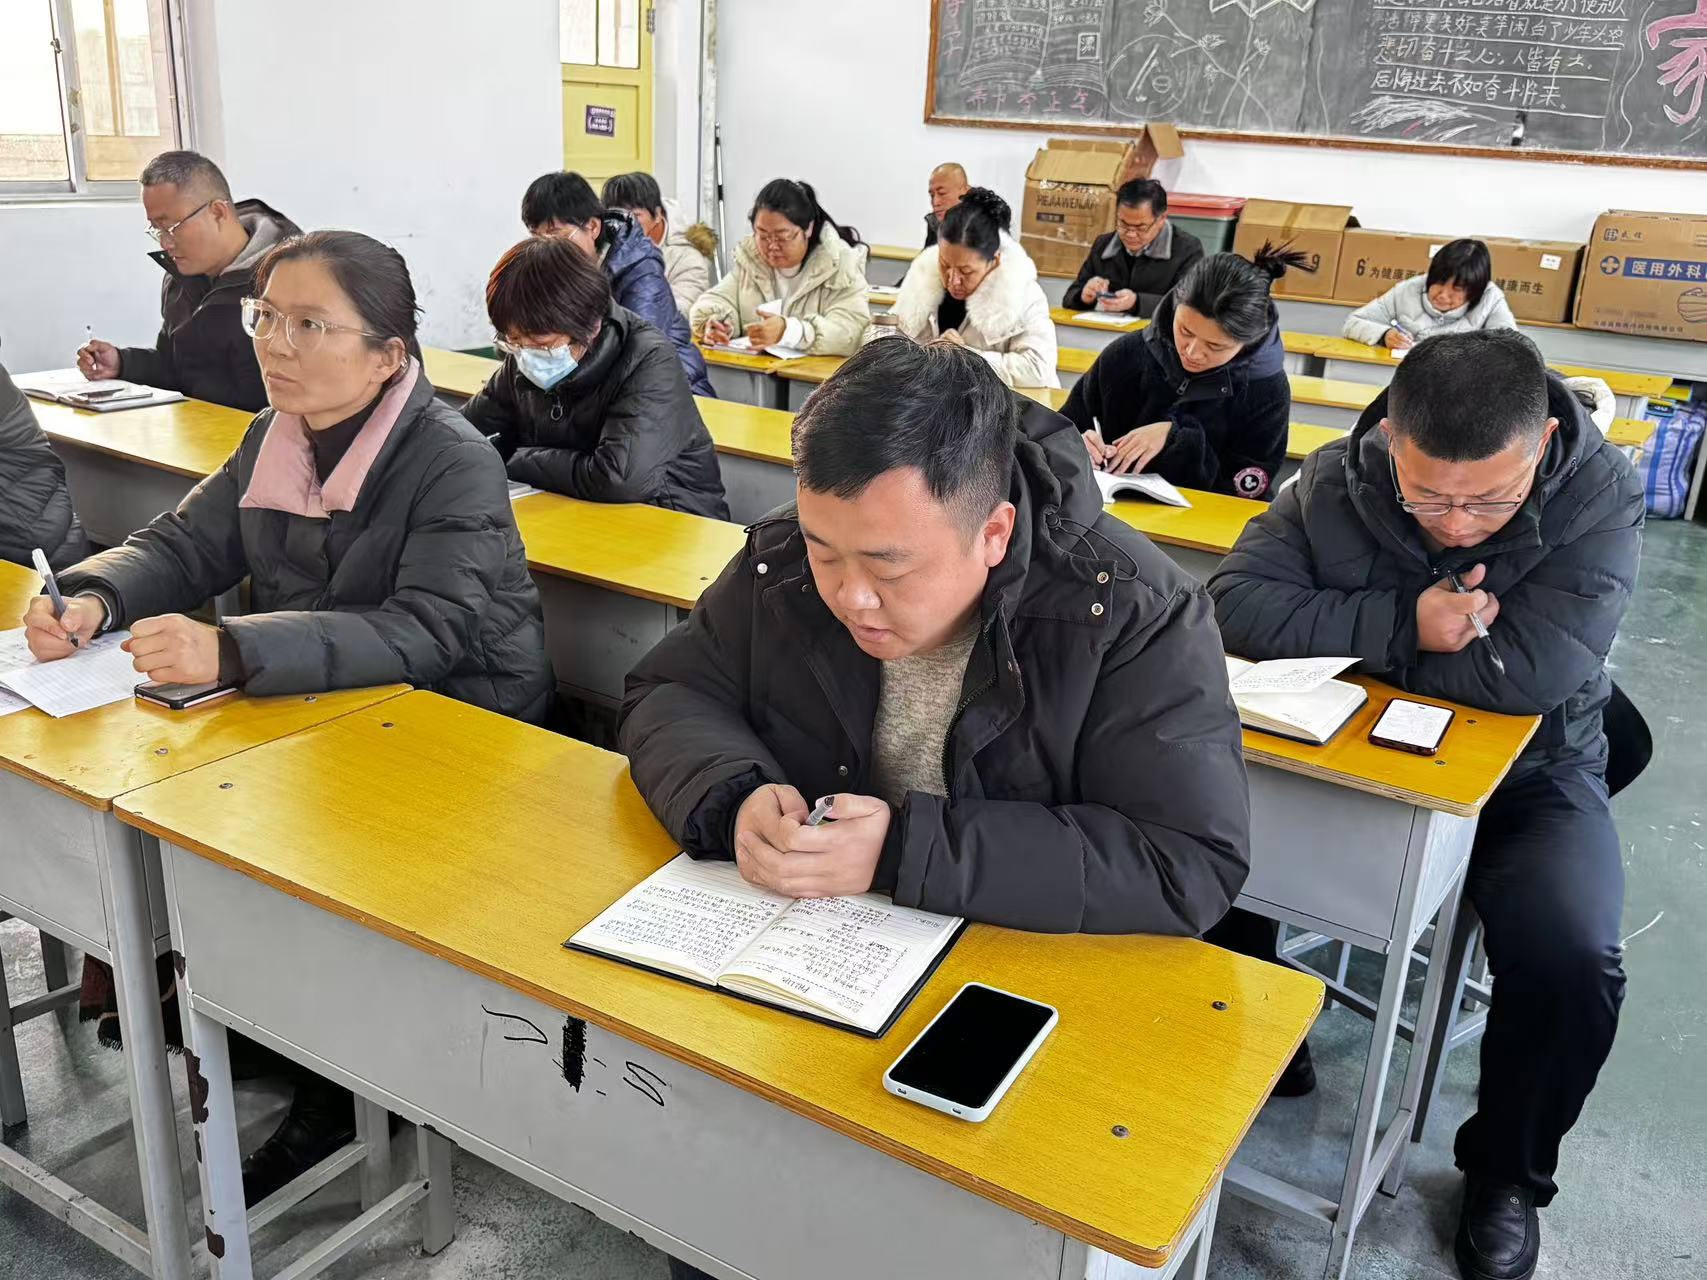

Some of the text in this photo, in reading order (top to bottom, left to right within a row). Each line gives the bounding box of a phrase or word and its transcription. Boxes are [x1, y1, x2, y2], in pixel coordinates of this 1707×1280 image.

[1369, 266, 1425, 281] 为健康而
[1630, 260, 1707, 280] 医用外科
